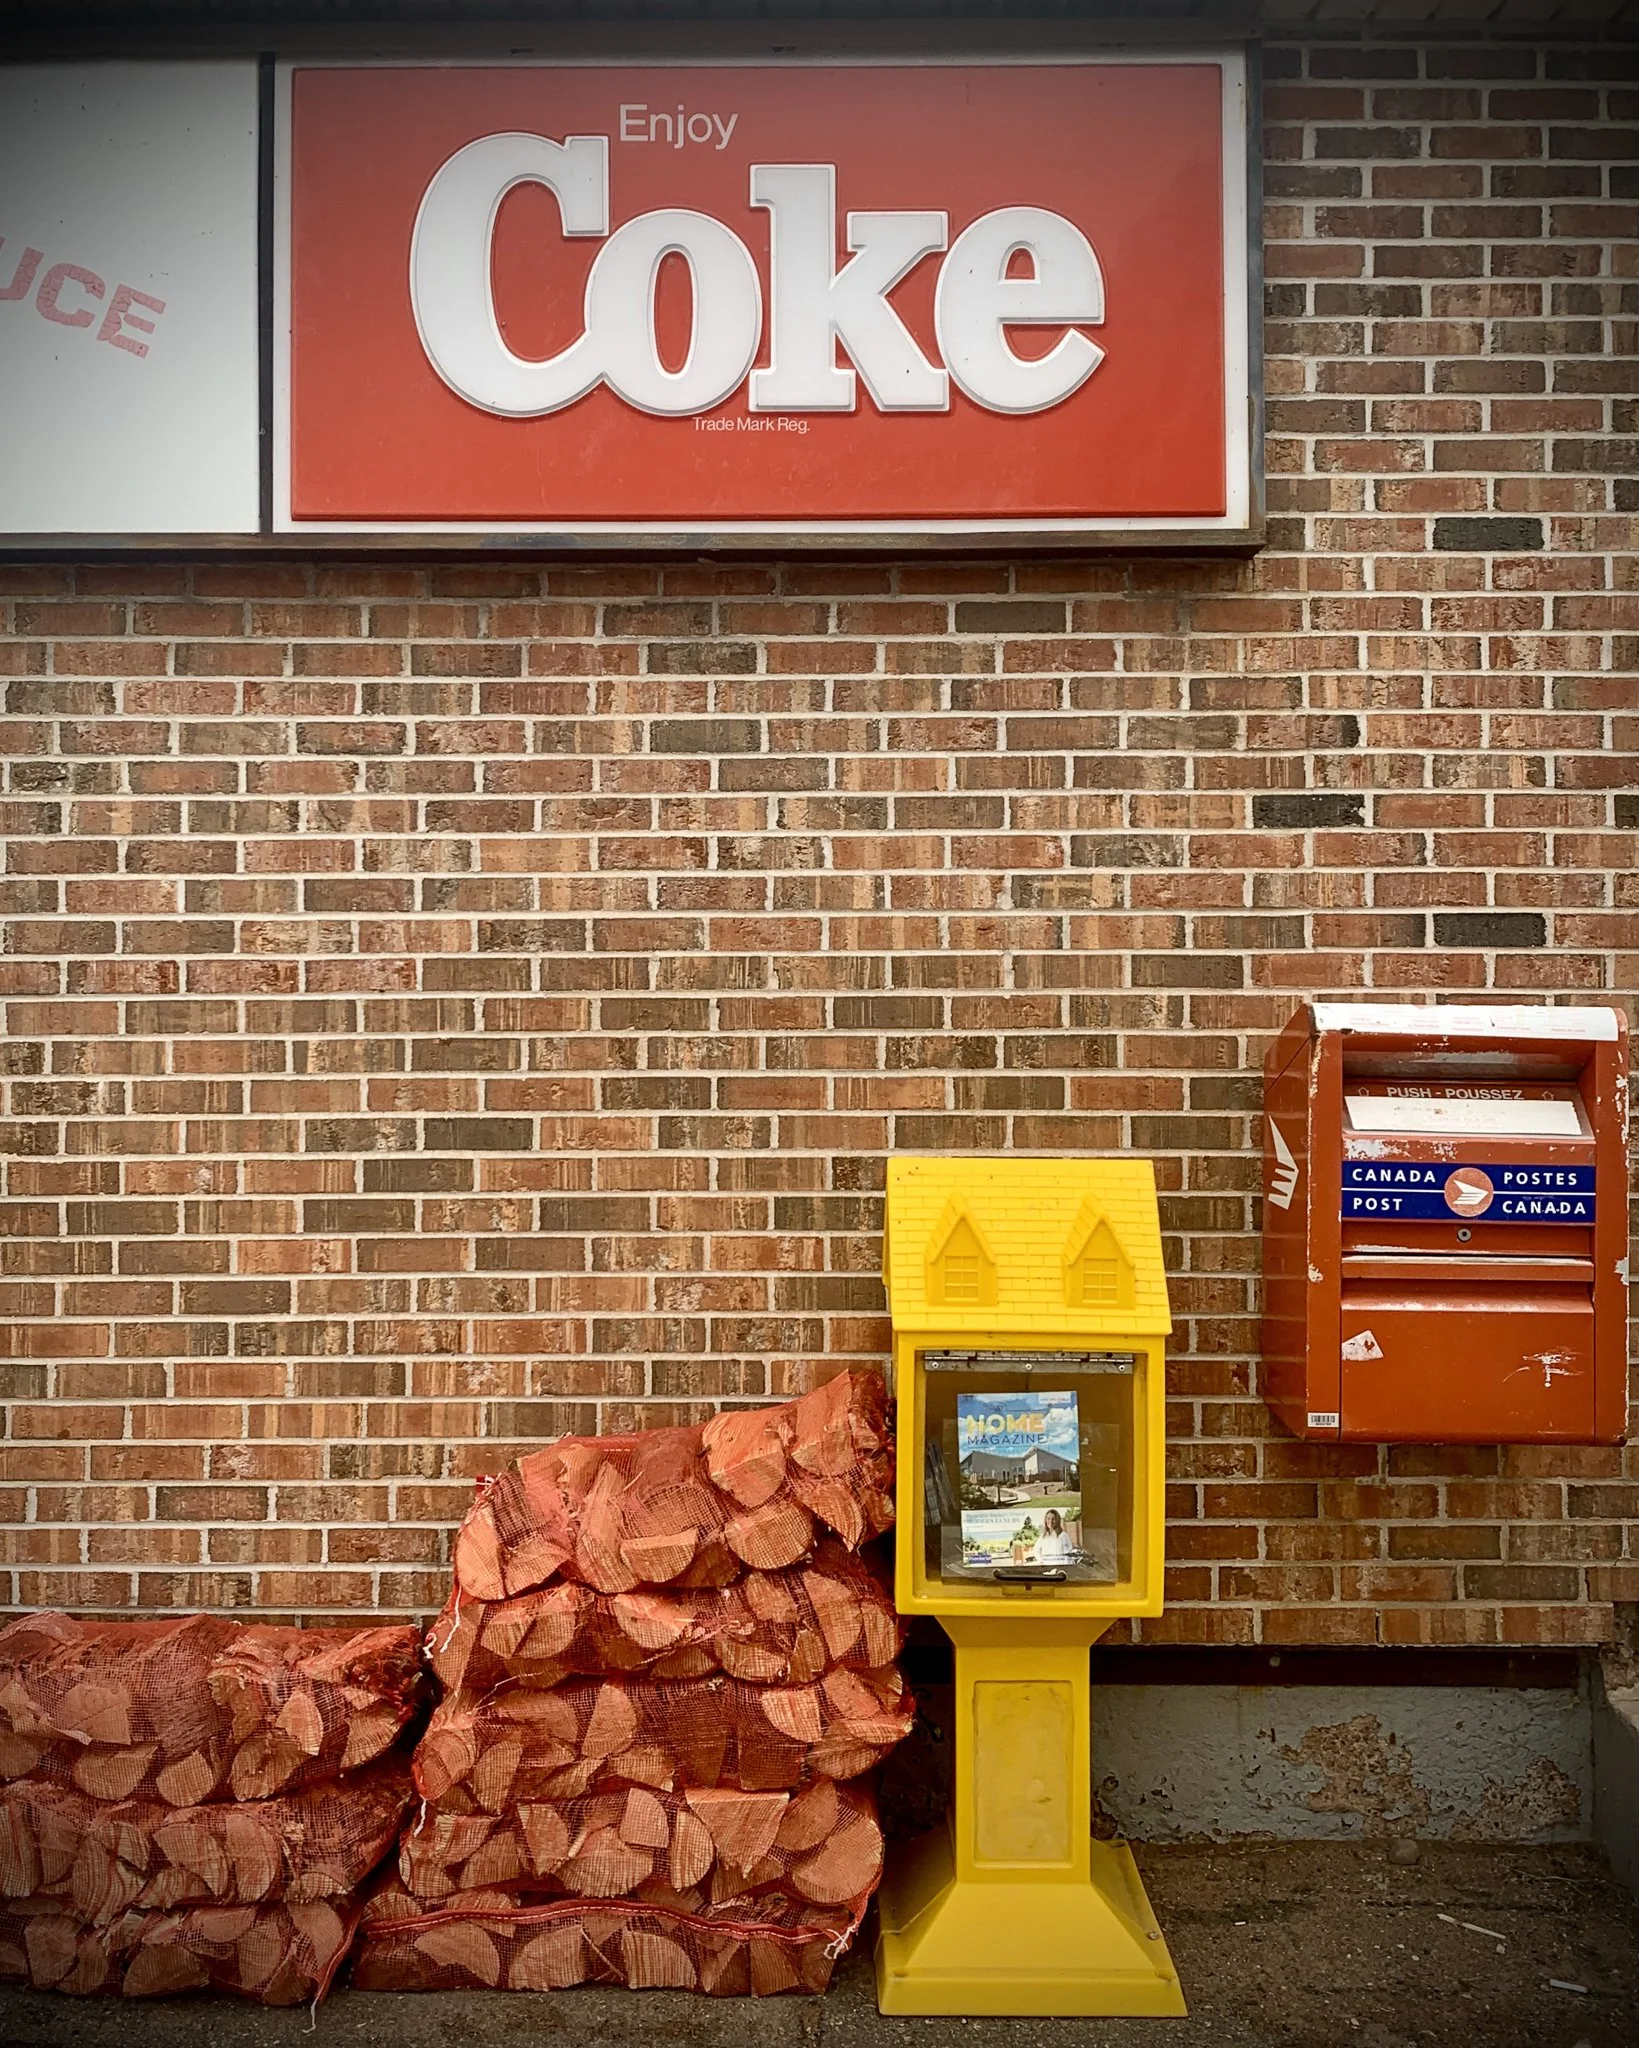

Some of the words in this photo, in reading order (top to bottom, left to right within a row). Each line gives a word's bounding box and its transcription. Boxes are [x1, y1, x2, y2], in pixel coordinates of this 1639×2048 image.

[619, 103, 740, 151] Enjoy
[409, 131, 1106, 418] Coke
[692, 416, 735, 432] Trade
[736, 416, 776, 432] Mark
[777, 416, 811, 435] Reg.
[1386, 1086, 1432, 1099] PUSH
[1445, 1087, 1525, 1101] POUSSEZ
[1351, 1168, 1437, 1183] CANADA
[1503, 1172, 1578, 1186] POSTES
[1352, 1197, 1404, 1212] POST
[1501, 1200, 1587, 1215] CANADA
[965, 1411, 1046, 1436] HOME
[967, 1433, 1048, 1446] MAGAZINE
